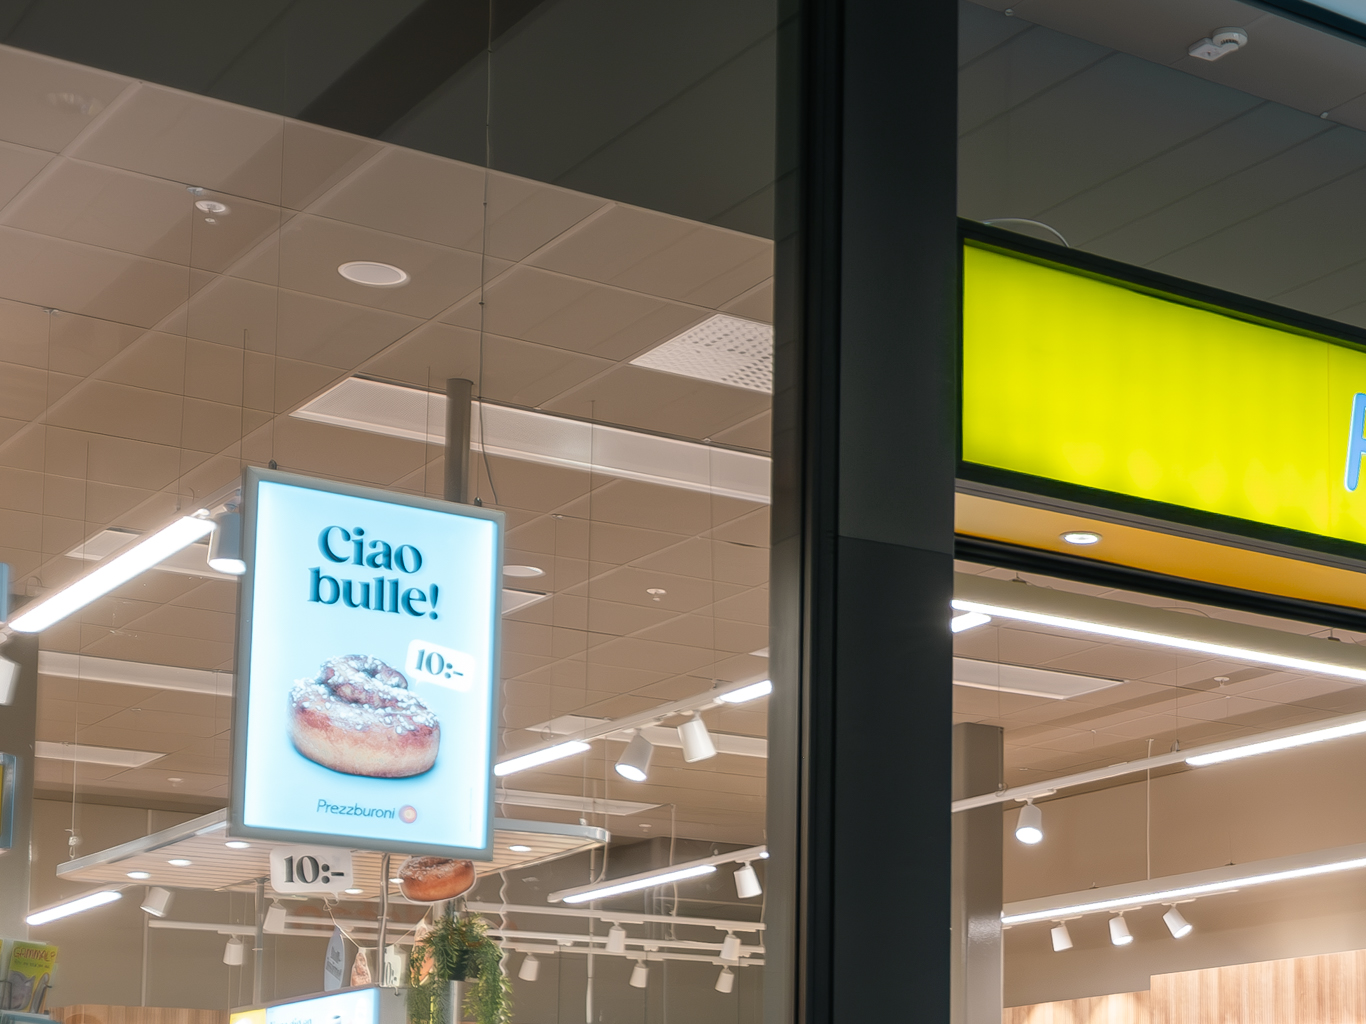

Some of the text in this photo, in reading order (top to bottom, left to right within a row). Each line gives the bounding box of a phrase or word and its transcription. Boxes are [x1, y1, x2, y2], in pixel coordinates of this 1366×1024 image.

[317, 525, 423, 574] Ciao
[307, 566, 440, 621] bulle!
[415, 649, 465, 679] 10:-
[316, 798, 396, 820] Prezzburoni
[284, 855, 345, 885] 10:-
